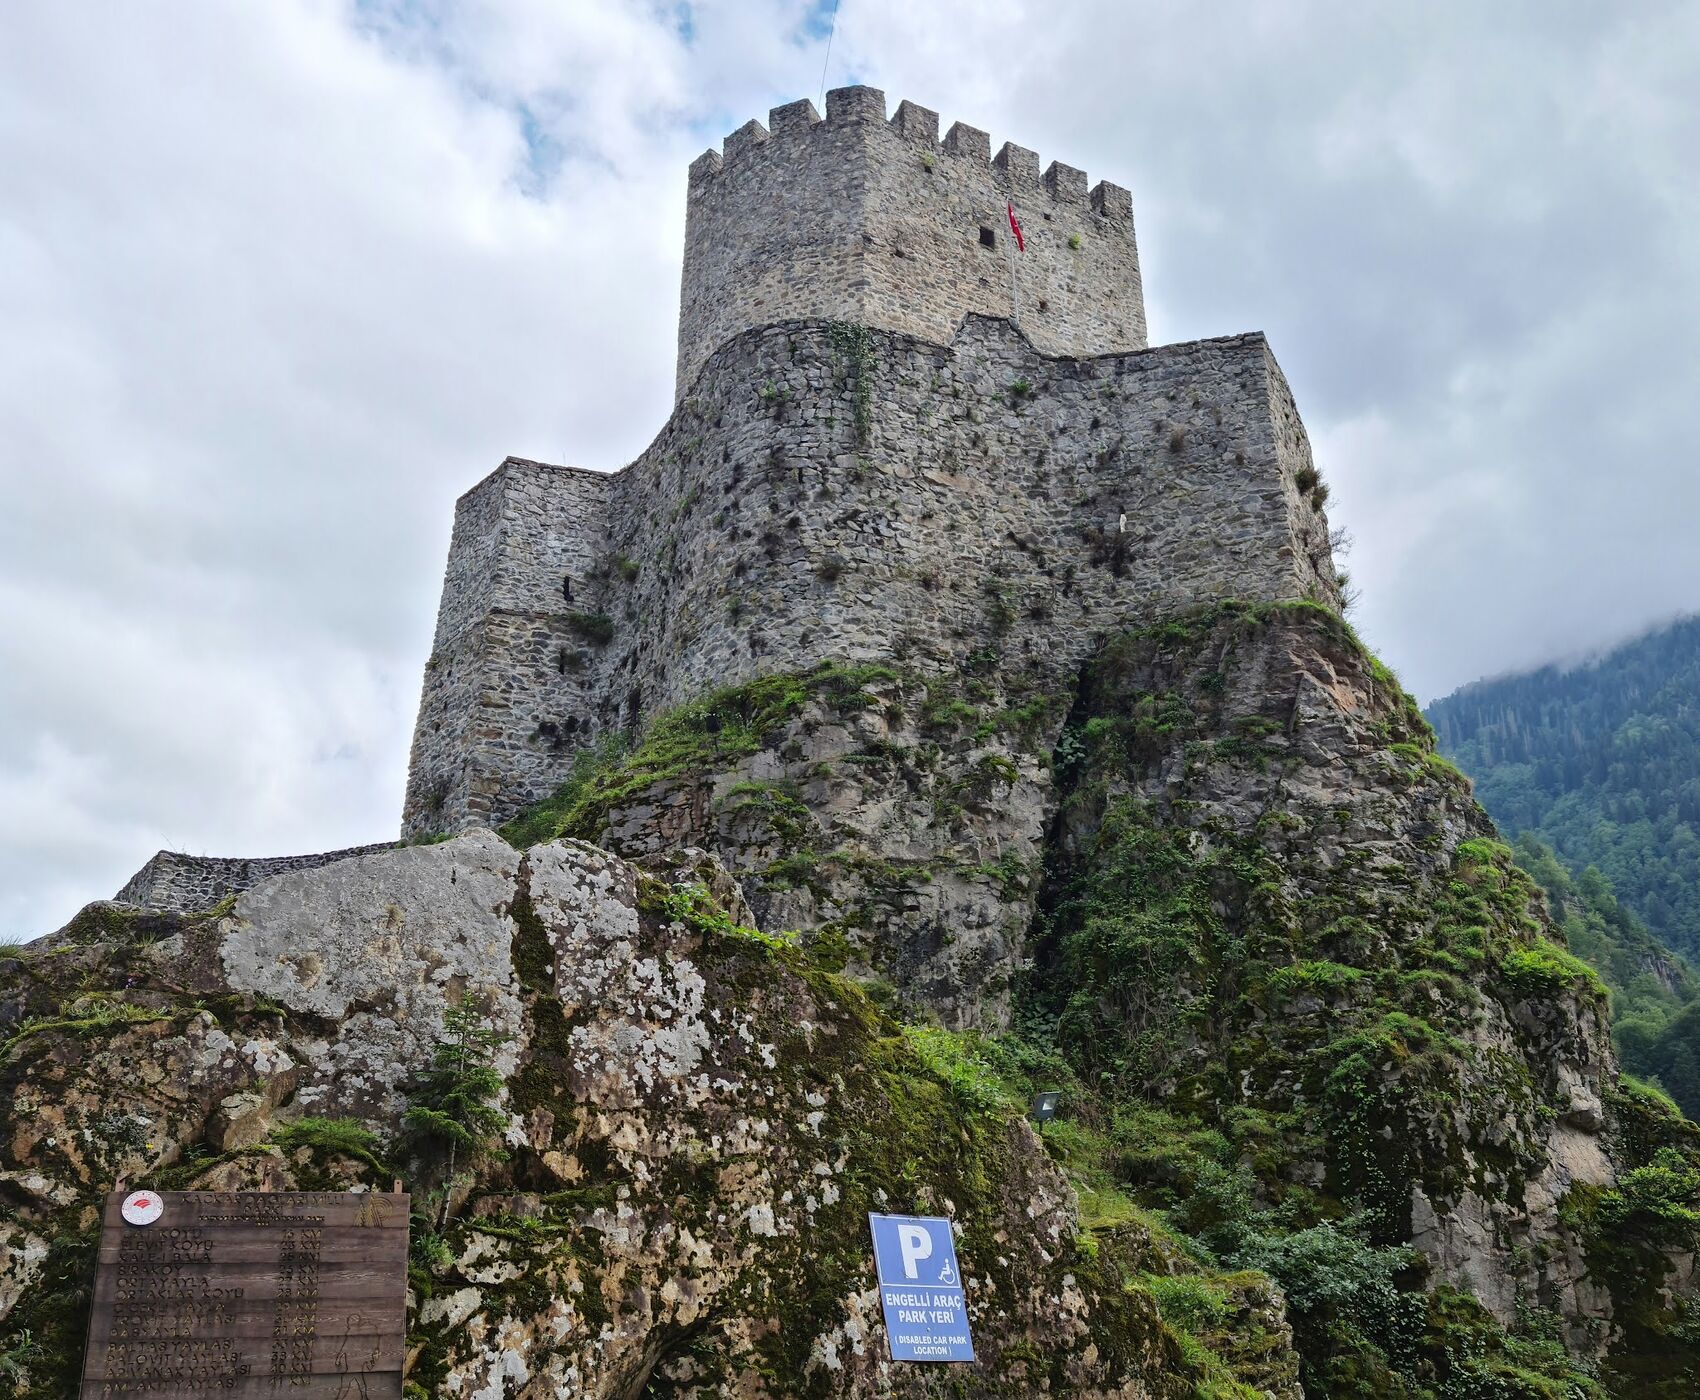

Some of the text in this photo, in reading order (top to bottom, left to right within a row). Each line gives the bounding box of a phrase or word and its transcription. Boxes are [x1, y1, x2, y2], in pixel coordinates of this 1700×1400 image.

[301, 1229, 321, 1239] KM
[300, 1241, 320, 1250] KM
[897, 1224, 933, 1279] P
[299, 1264, 319, 1275] KM
[298, 1276, 318, 1286] KM
[297, 1288, 318, 1298] KM
[296, 1301, 317, 1311] KM
[885, 1292, 962, 1310] ENGELLİ ARAÇ
[898, 1309, 954, 1324] PARK YERİ
[294, 1325, 315, 1336] KM
[293, 1338, 314, 1350] KM
[899, 1335, 932, 1345] DISABLED
[933, 1336, 948, 1345] CAR
[948, 1336, 967, 1345] PARK
[292, 1350, 313, 1361] KM
[913, 1346, 948, 1355] LOCATION
[291, 1362, 312, 1373] KM
[289, 1375, 311, 1386] KM
